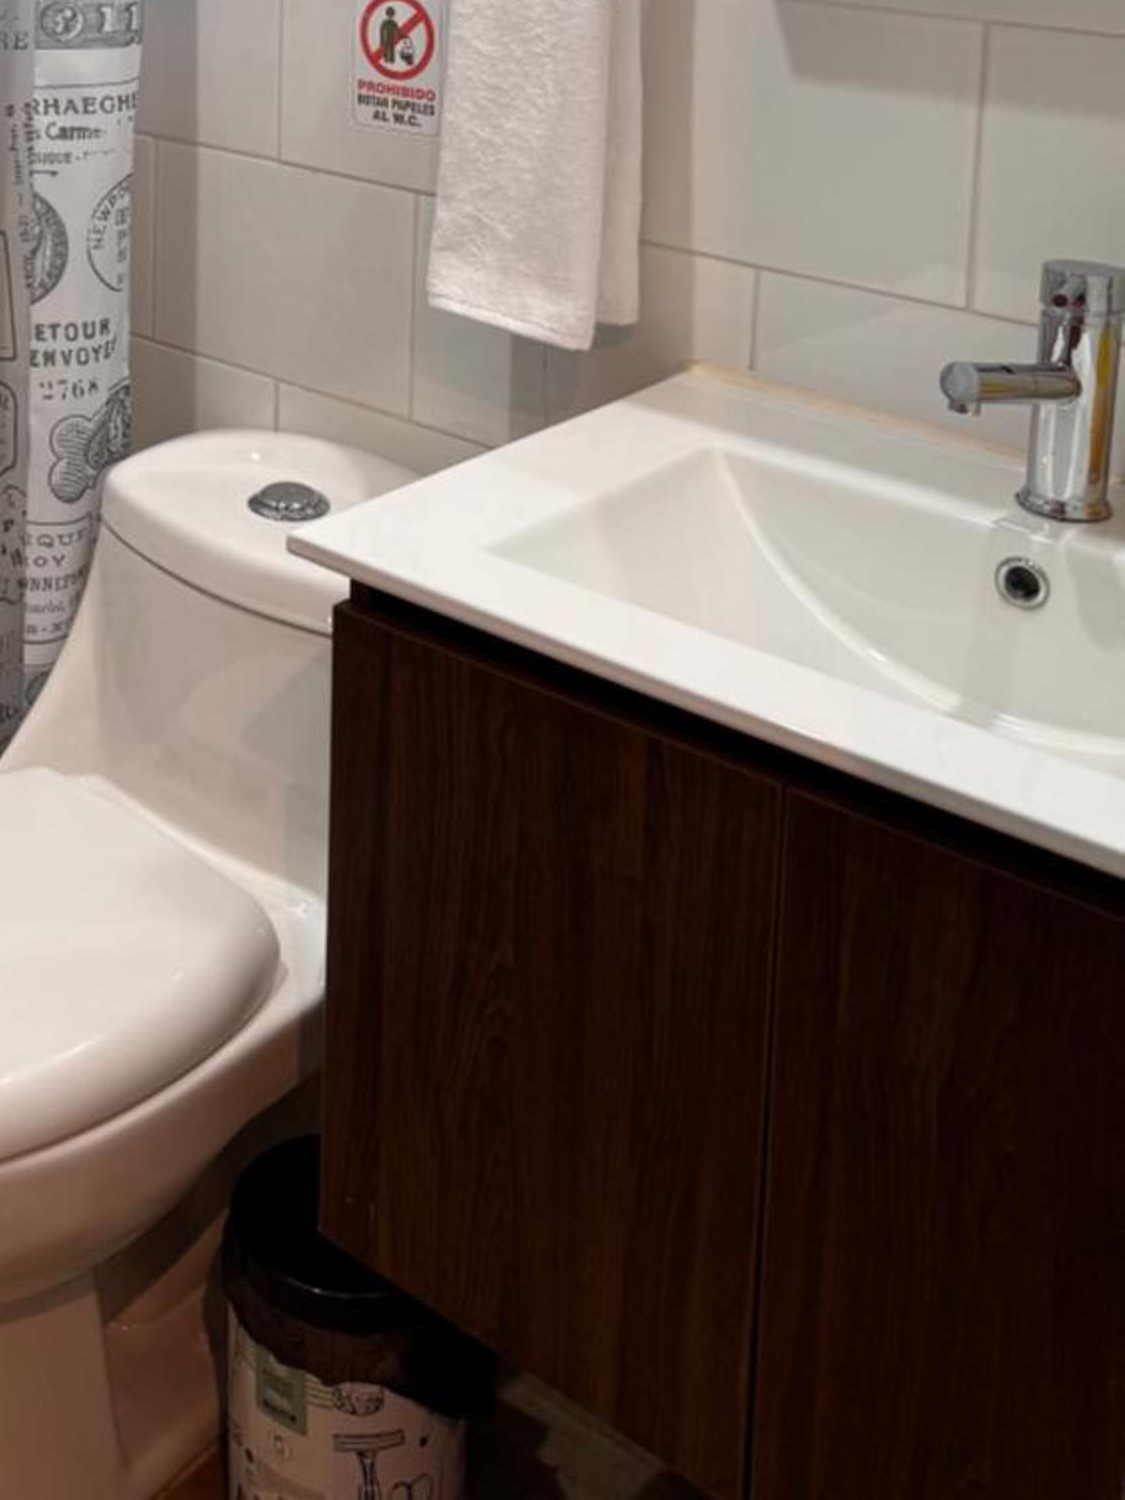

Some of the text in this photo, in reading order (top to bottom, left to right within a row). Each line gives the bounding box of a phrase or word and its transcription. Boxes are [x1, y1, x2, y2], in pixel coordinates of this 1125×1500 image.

[357, 79, 436, 102] PROHIBIDO
[372, 109, 390, 122] AL
[391, 98, 436, 116] PAPELES
